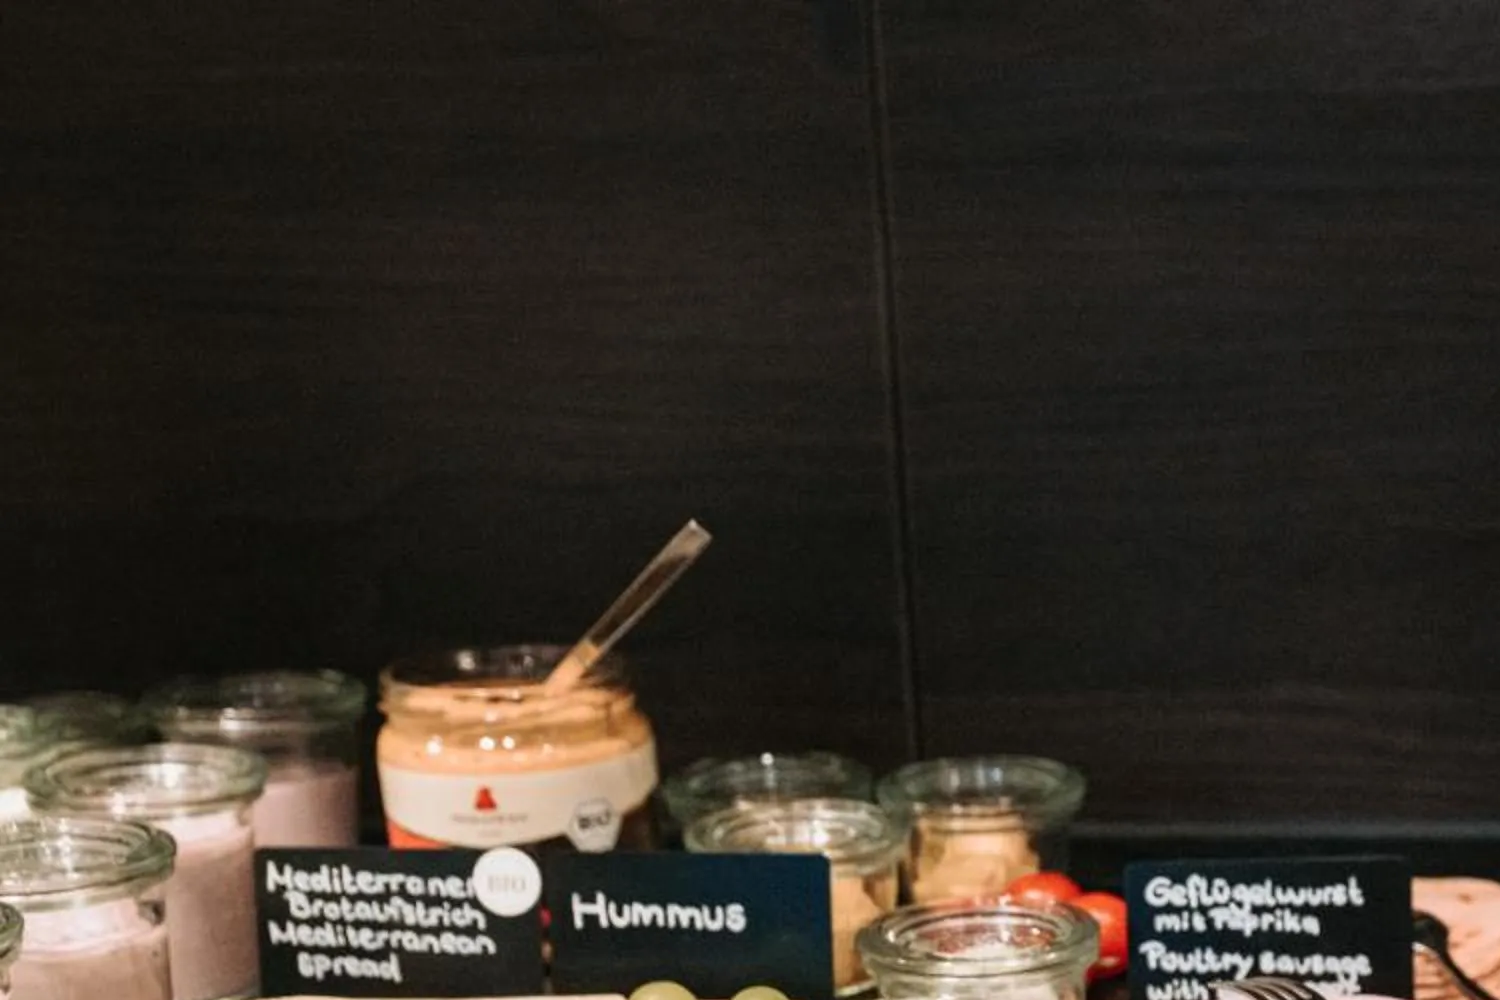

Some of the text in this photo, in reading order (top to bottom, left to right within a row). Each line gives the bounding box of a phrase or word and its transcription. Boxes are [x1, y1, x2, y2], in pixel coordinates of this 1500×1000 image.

[285, 890, 487, 930] Brotaufstrich
[571, 890, 747, 933] Hummus
[1153, 901, 1320, 937] mit Paprika
[268, 919, 497, 955] Mediterranean
[297, 951, 402, 983] spread
[1138, 940, 1254, 981] Poultry
[1258, 950, 1374, 994] sausage
